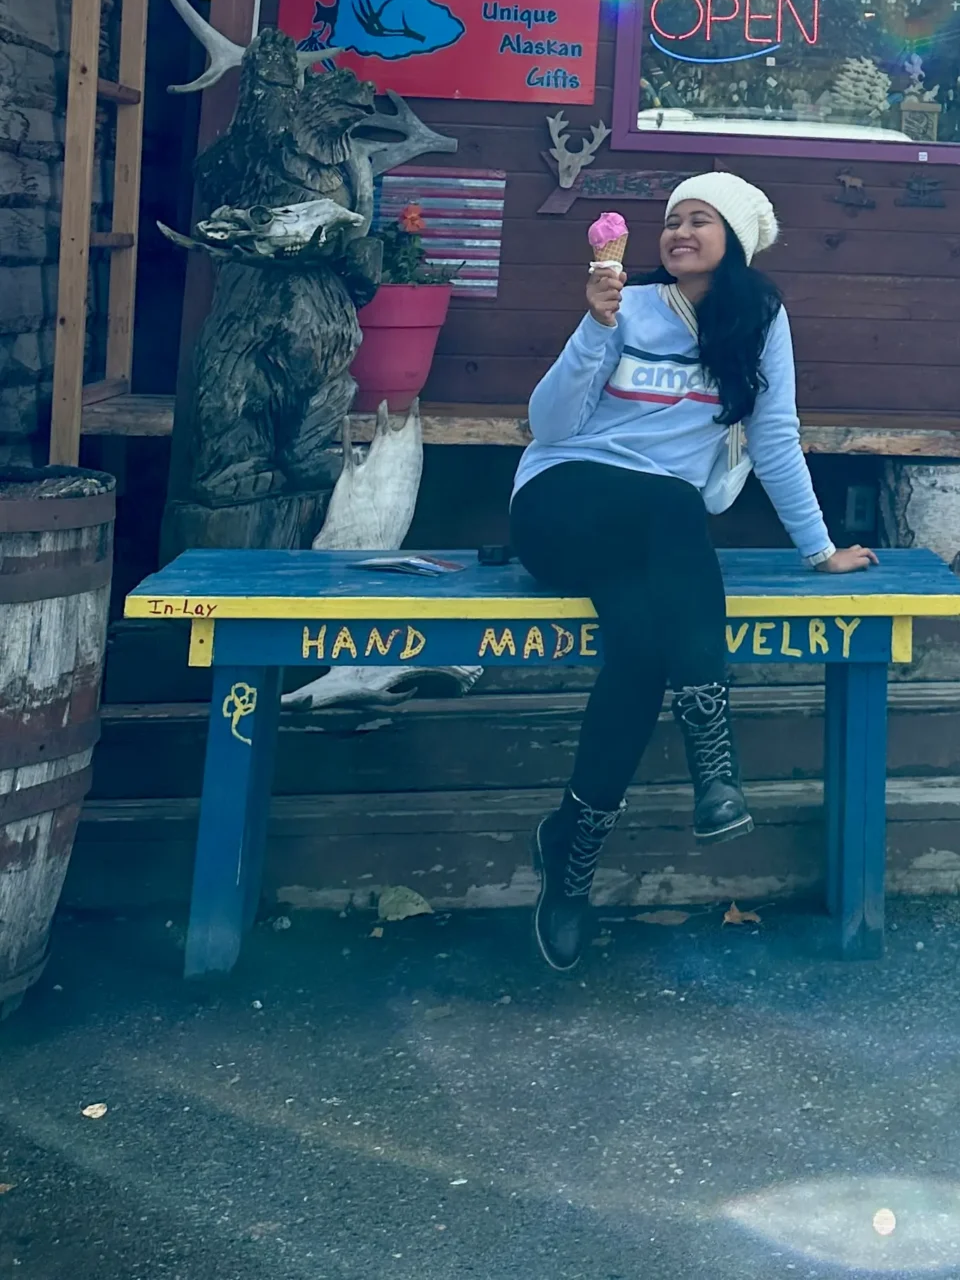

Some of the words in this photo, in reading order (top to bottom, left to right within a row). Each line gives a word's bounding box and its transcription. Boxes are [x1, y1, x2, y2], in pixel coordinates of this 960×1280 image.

[482, 1, 558, 31] Unique
[499, 33, 583, 58] Alaskan
[526, 66, 581, 90] Gifts
[147, 599, 218, 618] In-Lay
[301, 623, 427, 661] HAND
[478, 622, 600, 661] MADE
